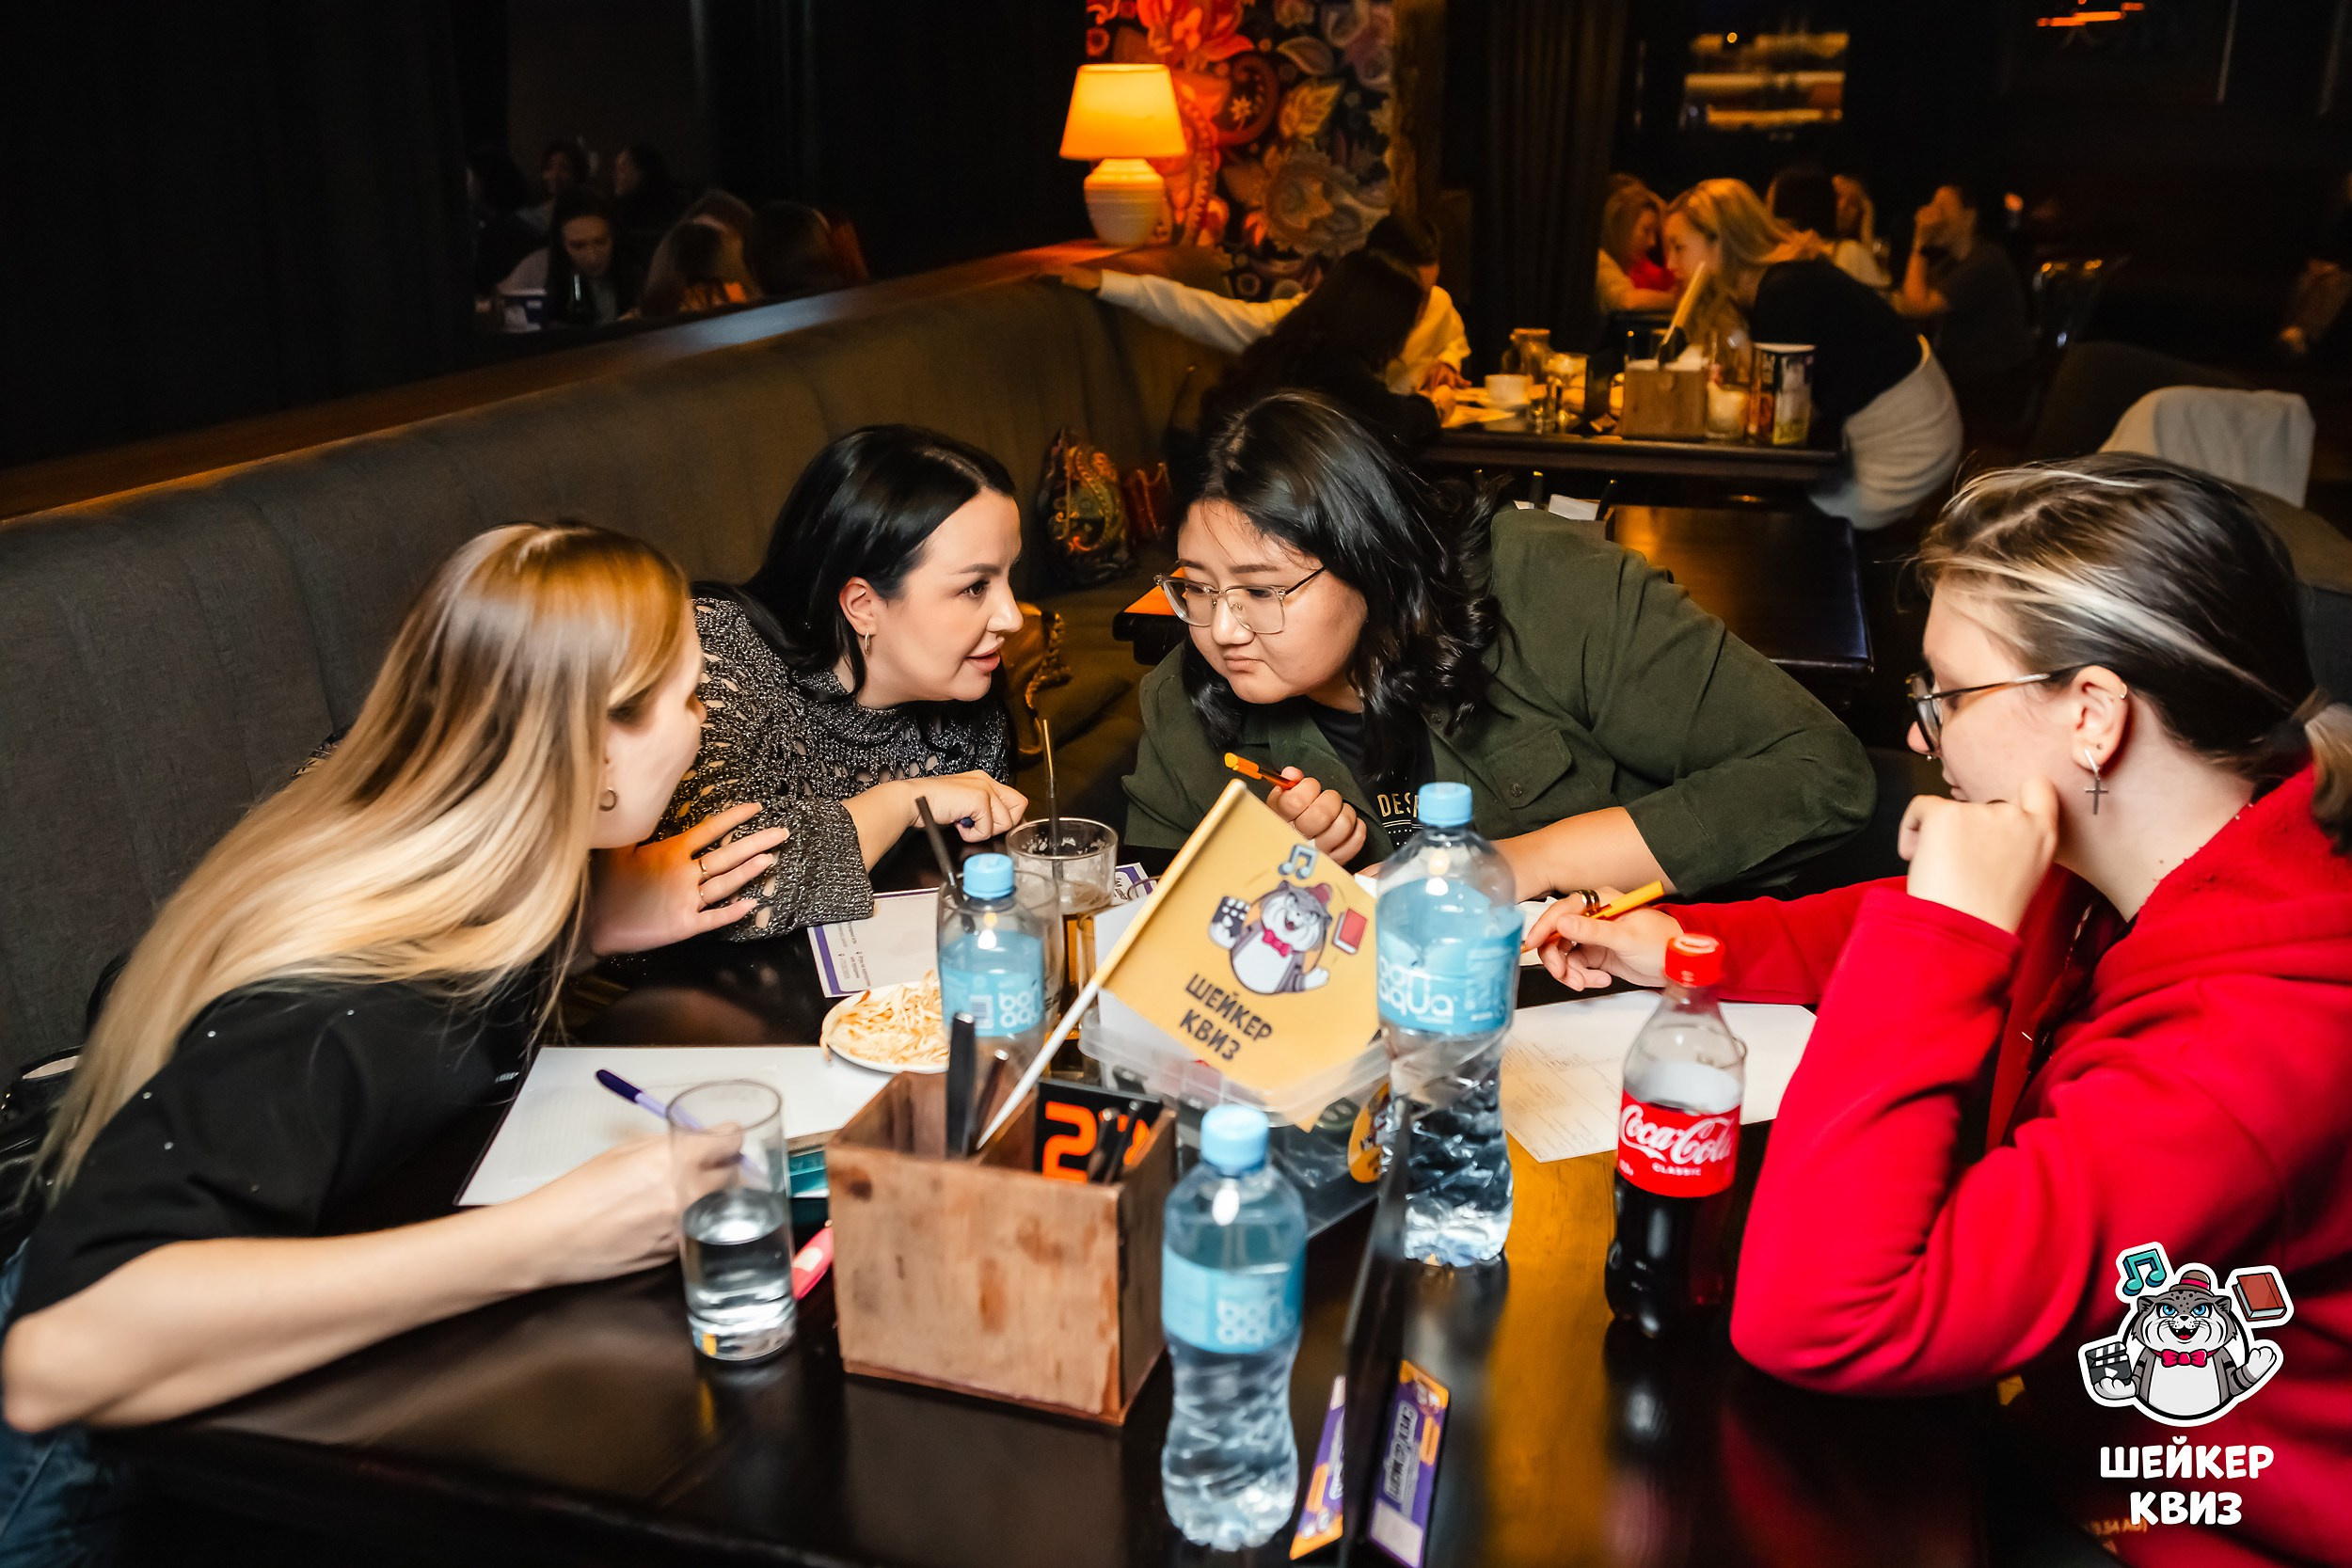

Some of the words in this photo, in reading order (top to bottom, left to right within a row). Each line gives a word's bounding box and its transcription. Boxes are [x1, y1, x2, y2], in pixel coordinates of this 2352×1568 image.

[1179, 1008, 1241, 1061] КВИЗ
[1185, 973, 1273, 1040] ШЕЙКЕР
[1042, 1100, 1150, 1183] 2
